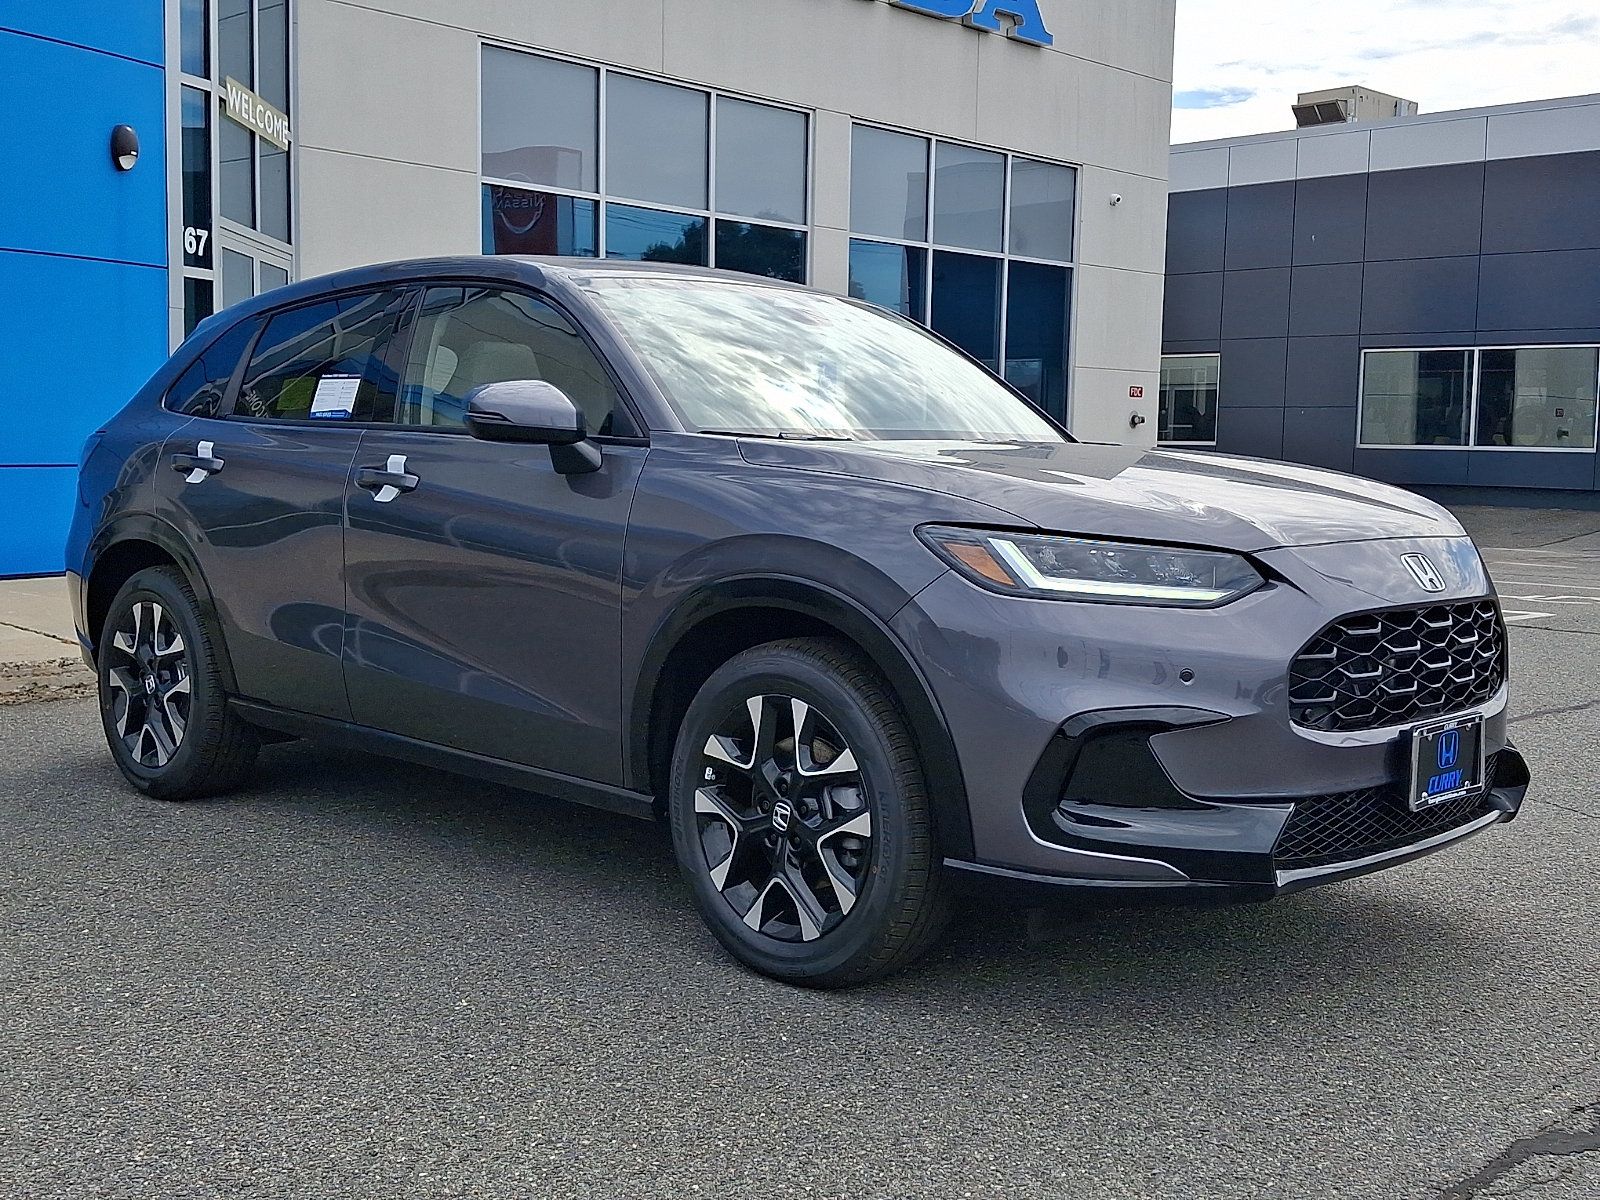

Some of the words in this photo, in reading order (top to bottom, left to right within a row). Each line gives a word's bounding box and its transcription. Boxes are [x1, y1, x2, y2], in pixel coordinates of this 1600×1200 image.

[226, 82, 290, 145] WELCOME
[182, 225, 209, 257] 67
[1130, 387, 1142, 397] FDC
[1427, 768, 1463, 795] CURRY
